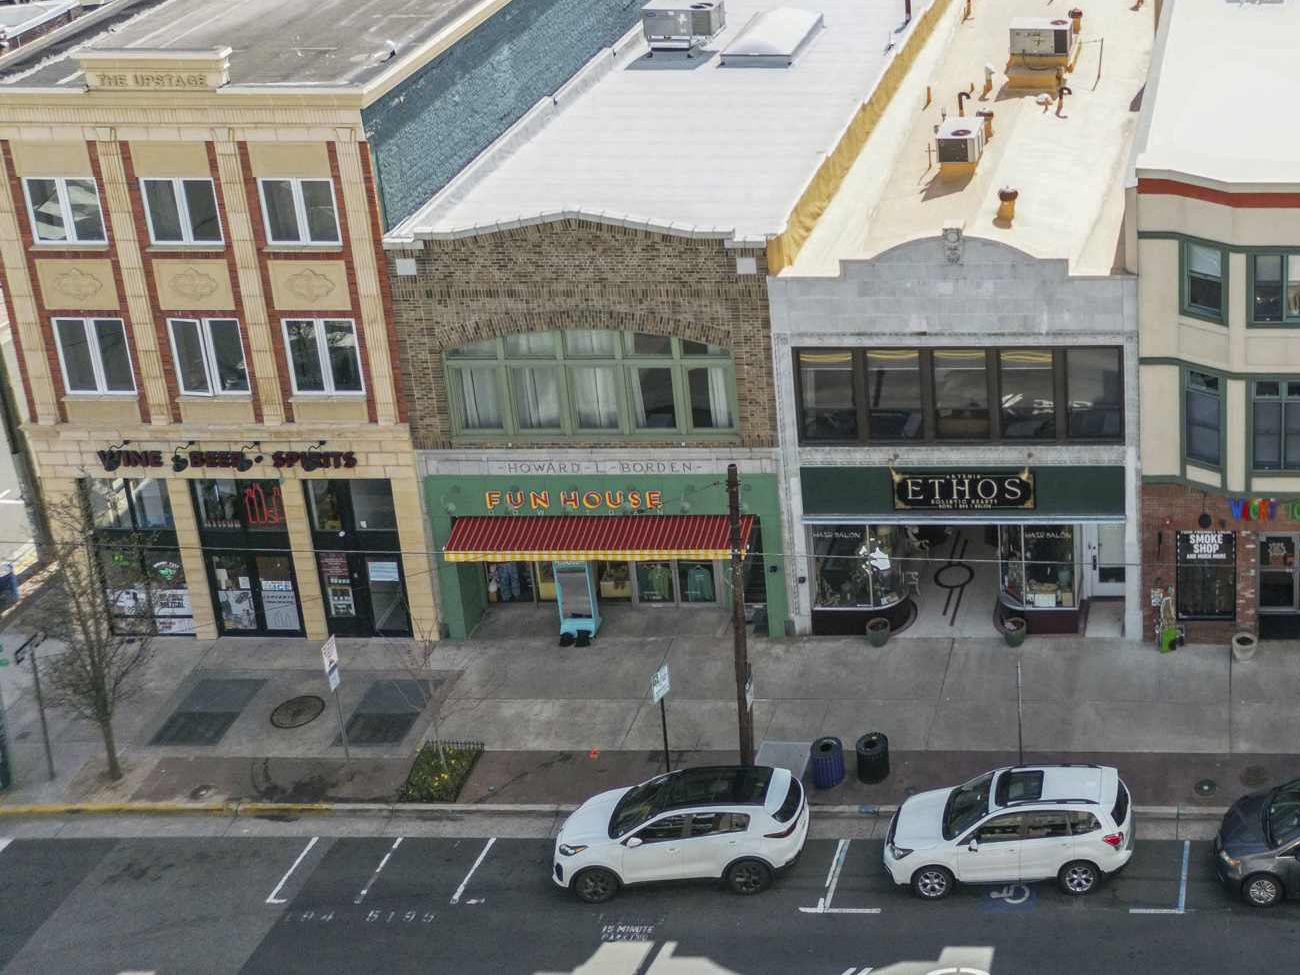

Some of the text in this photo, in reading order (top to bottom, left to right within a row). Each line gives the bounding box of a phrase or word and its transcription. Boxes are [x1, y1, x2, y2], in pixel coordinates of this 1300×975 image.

[96, 74, 208, 88] THE UPSTAGE
[97, 450, 163, 469] WINE
[508, 462, 580, 473] HOWARD
[621, 462, 692, 473] BORDEN
[906, 478, 1021, 500] ETHOS
[486, 491, 663, 510] FUN HOUSE
[1228, 498, 1278, 522] WACKY
[1189, 534, 1223, 544] SMOKE
[1193, 544, 1220, 553] SHOP
[602, 925, 654, 933] 15 MINUTE
